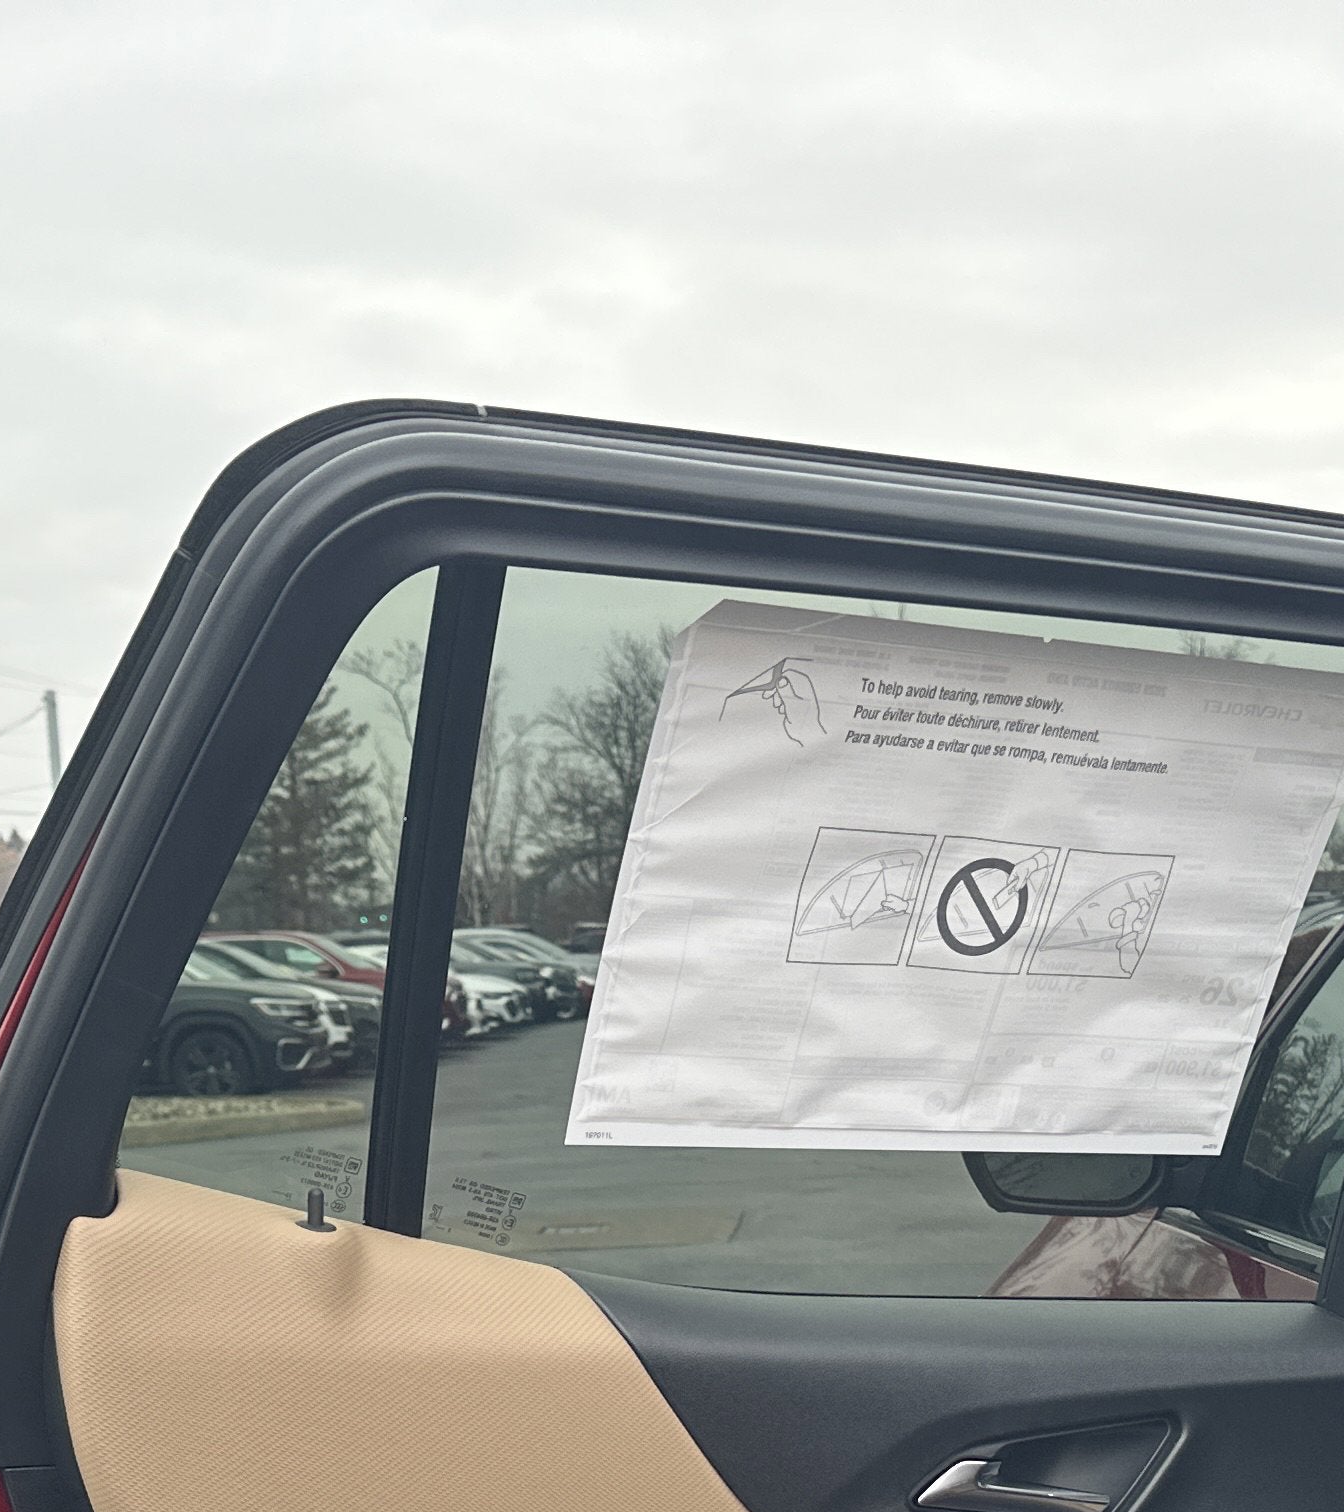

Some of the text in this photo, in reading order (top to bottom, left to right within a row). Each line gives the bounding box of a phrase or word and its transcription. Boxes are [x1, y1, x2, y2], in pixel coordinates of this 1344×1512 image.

[861, 677, 1065, 714] To help avoid tearing, remove slowly.
[853, 704, 1101, 743] Pour éviter toute déchirure, retirer lentement.
[845, 730, 1169, 774] Para ayudarse a evitar que se rompa, remuévala lentamente.
